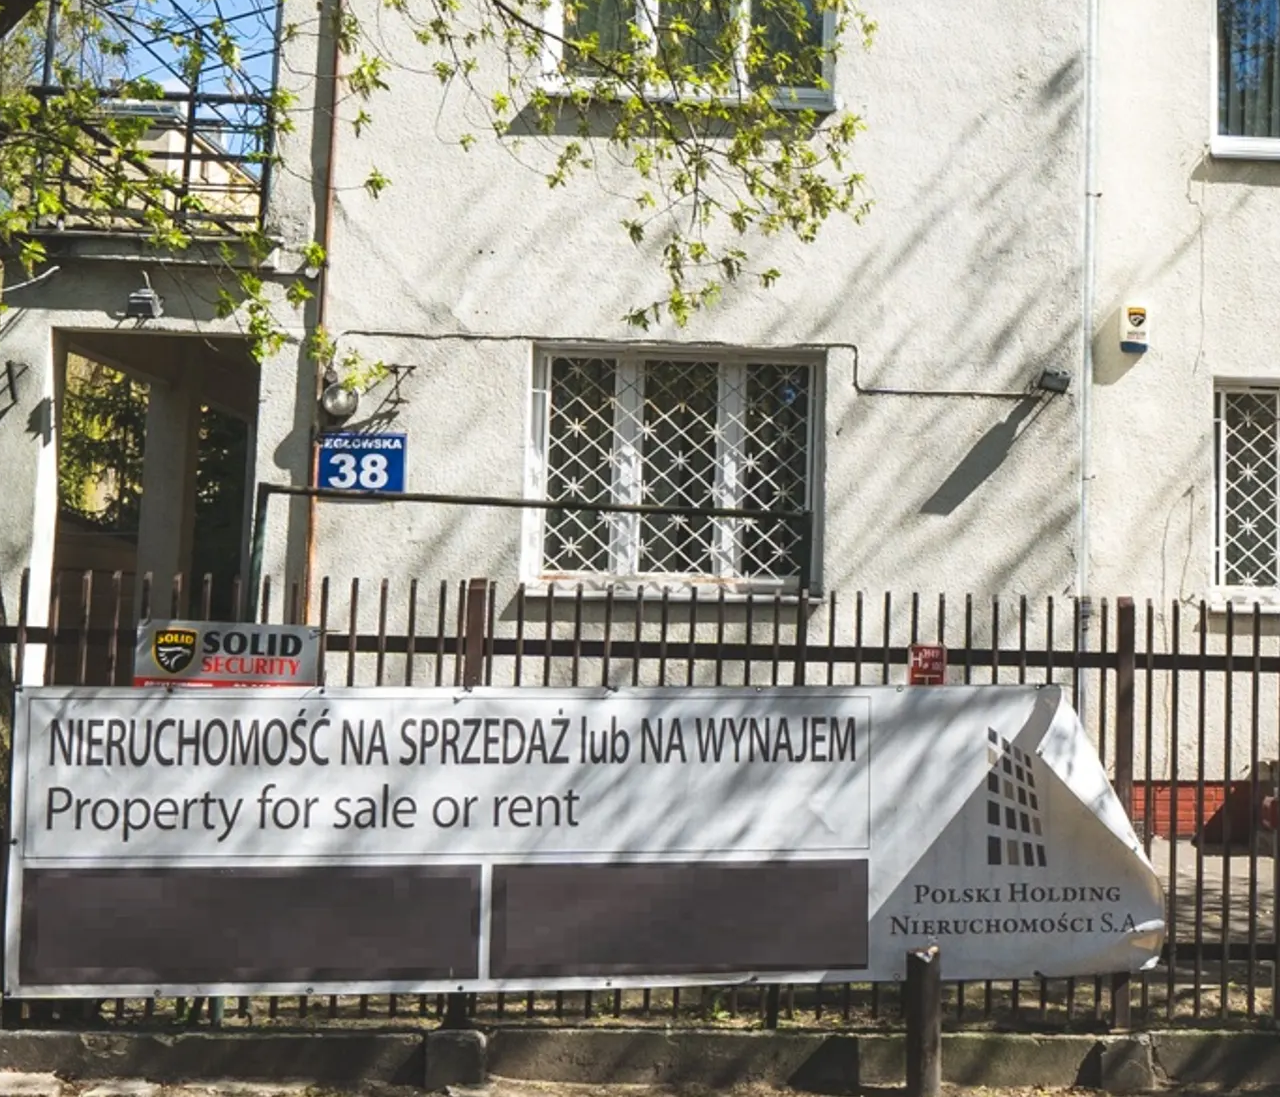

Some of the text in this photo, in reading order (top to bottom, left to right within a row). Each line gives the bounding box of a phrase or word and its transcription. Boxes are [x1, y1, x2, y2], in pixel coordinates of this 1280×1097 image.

[320, 437, 402, 449] EGŁOWSKA
[328, 453, 389, 489] 38
[157, 631, 303, 657] SOLID SOLID
[201, 656, 301, 676] SECURITY
[48, 708, 857, 767] NIERUCHOMOŚĆ NA SPRZEDAŻ lub NA WYNAJEM
[46, 784, 581, 843] Property for sale or rent
[1100, 912, 1145, 934] S.A.
